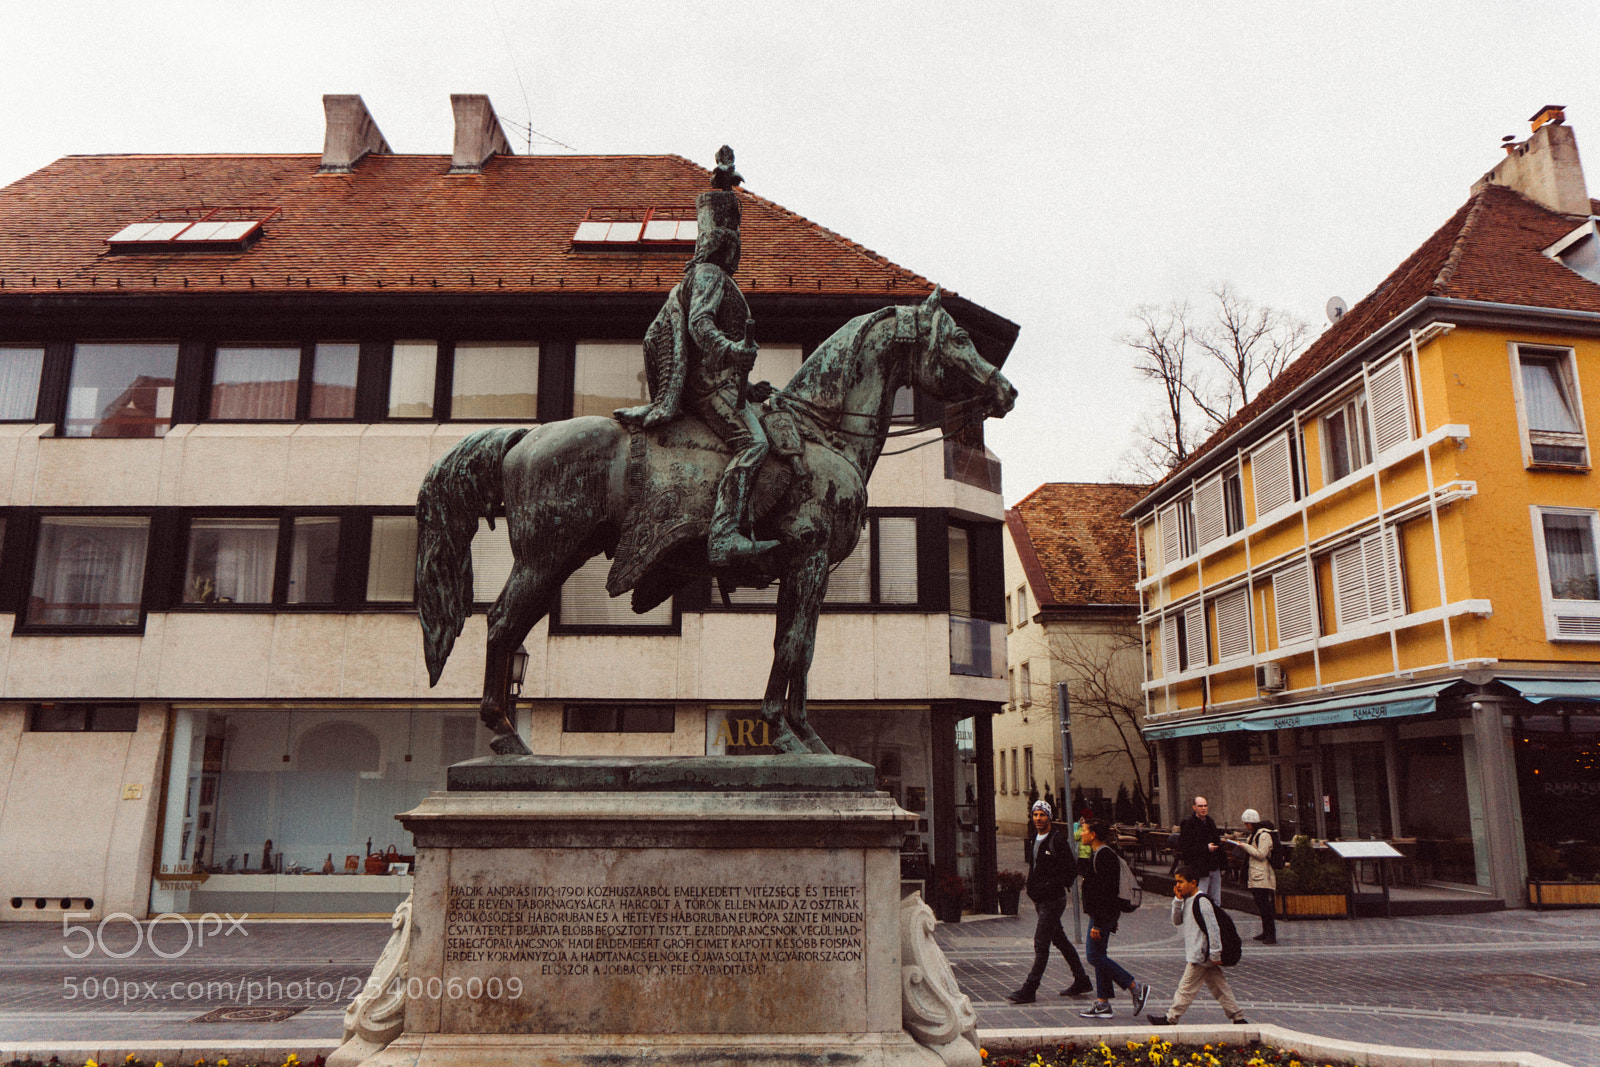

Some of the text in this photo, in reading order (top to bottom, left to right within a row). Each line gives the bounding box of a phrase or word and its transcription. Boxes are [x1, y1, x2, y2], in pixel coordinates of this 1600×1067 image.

[1352, 705, 1388, 720] RAMAZURI
[712, 718, 772, 747] ART
[1543, 782, 1600, 796] RAMAZU
[160, 881, 199, 891] ENTRANCE
[450, 886, 483, 898] HADIK
[487, 884, 530, 898] ANDRÁS
[674, 886, 742, 898] EMELKEDETT
[805, 884, 818, 898] ÉS
[620, 899, 670, 910] HARCOLT
[724, 899, 756, 910] ELLEN
[759, 899, 789, 910] MAJD
[792, 899, 807, 910] AZ
[738, 910, 779, 923] EURÓPA
[782, 912, 818, 923] SZINTE
[821, 912, 863, 923] MINDEN
[595, 925, 655, 936] BEOSZTOTT
[568, 938, 593, 949] HADI
[731, 938, 772, 949] KAPOTT
[702, 951, 758, 962] JAVASOLTA
